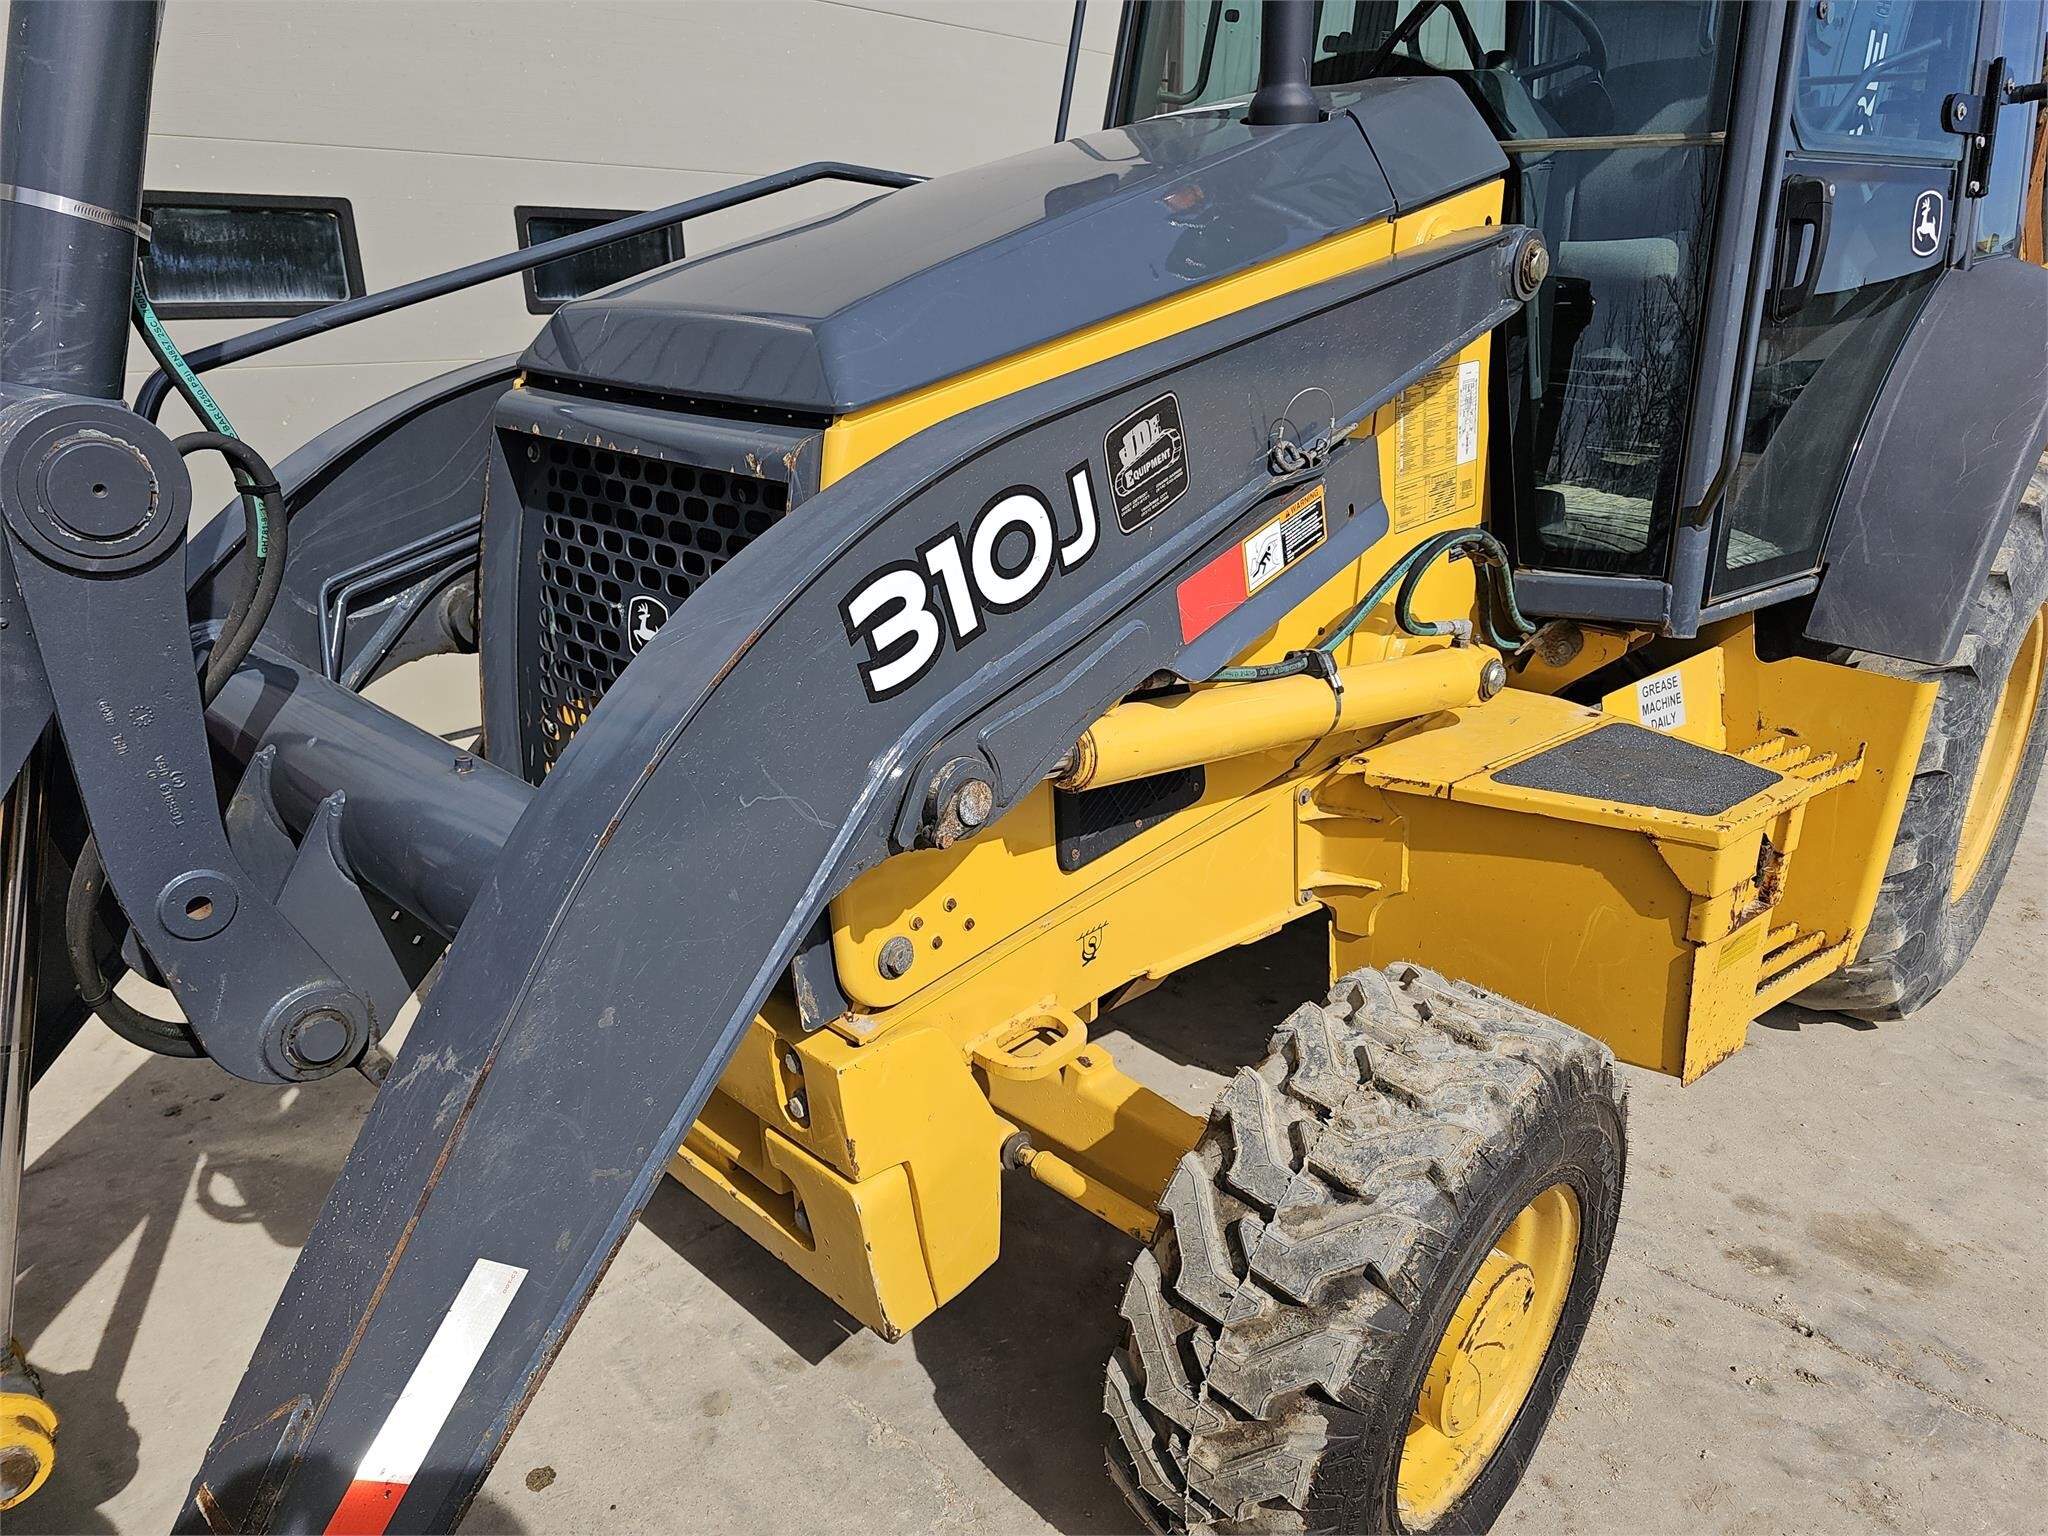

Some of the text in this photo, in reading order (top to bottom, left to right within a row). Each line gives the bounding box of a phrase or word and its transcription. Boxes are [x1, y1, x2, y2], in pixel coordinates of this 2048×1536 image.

[150, 320, 165, 338] 2SC
[160, 337, 184, 369] EN857
[183, 370, 200, 389] PSI)
[196, 388, 217, 412] (4250
[213, 411, 231, 432] BAR
[1119, 413, 1161, 468] JDE
[1125, 447, 1171, 489] EQUIPMENT
[1290, 489, 1319, 513] WARNING
[848, 469, 1097, 692] 310J
[1642, 676, 1678, 698] GREASE
[1642, 692, 1682, 716] MACHINE
[1651, 712, 1676, 729] DAILY
